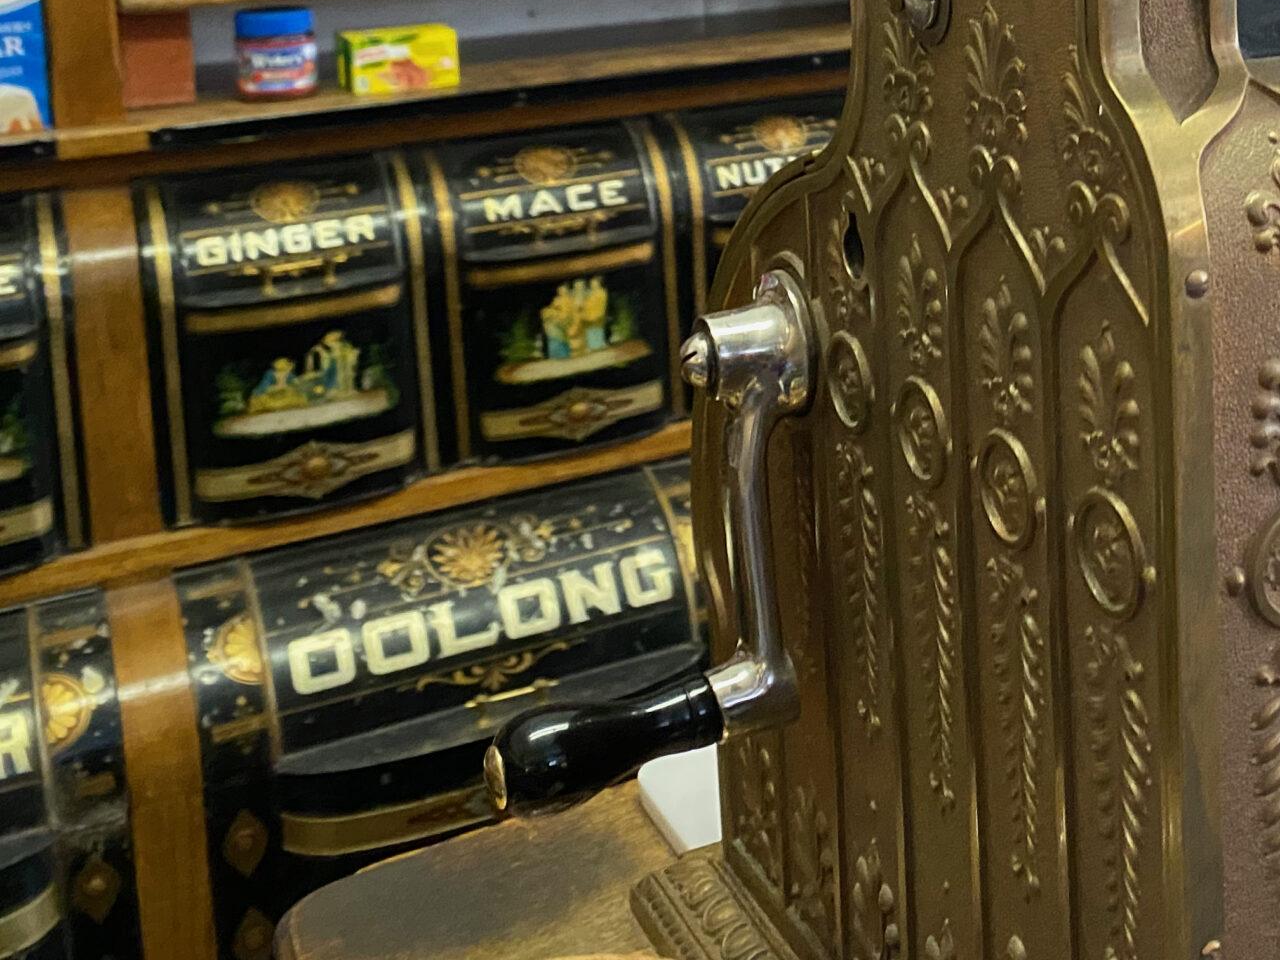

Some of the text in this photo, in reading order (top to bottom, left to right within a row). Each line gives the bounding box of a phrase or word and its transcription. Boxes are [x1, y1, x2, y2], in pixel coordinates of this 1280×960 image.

[482, 179, 629, 222] MACE
[197, 214, 375, 267] GINGER
[288, 548, 673, 695] OOLONG
